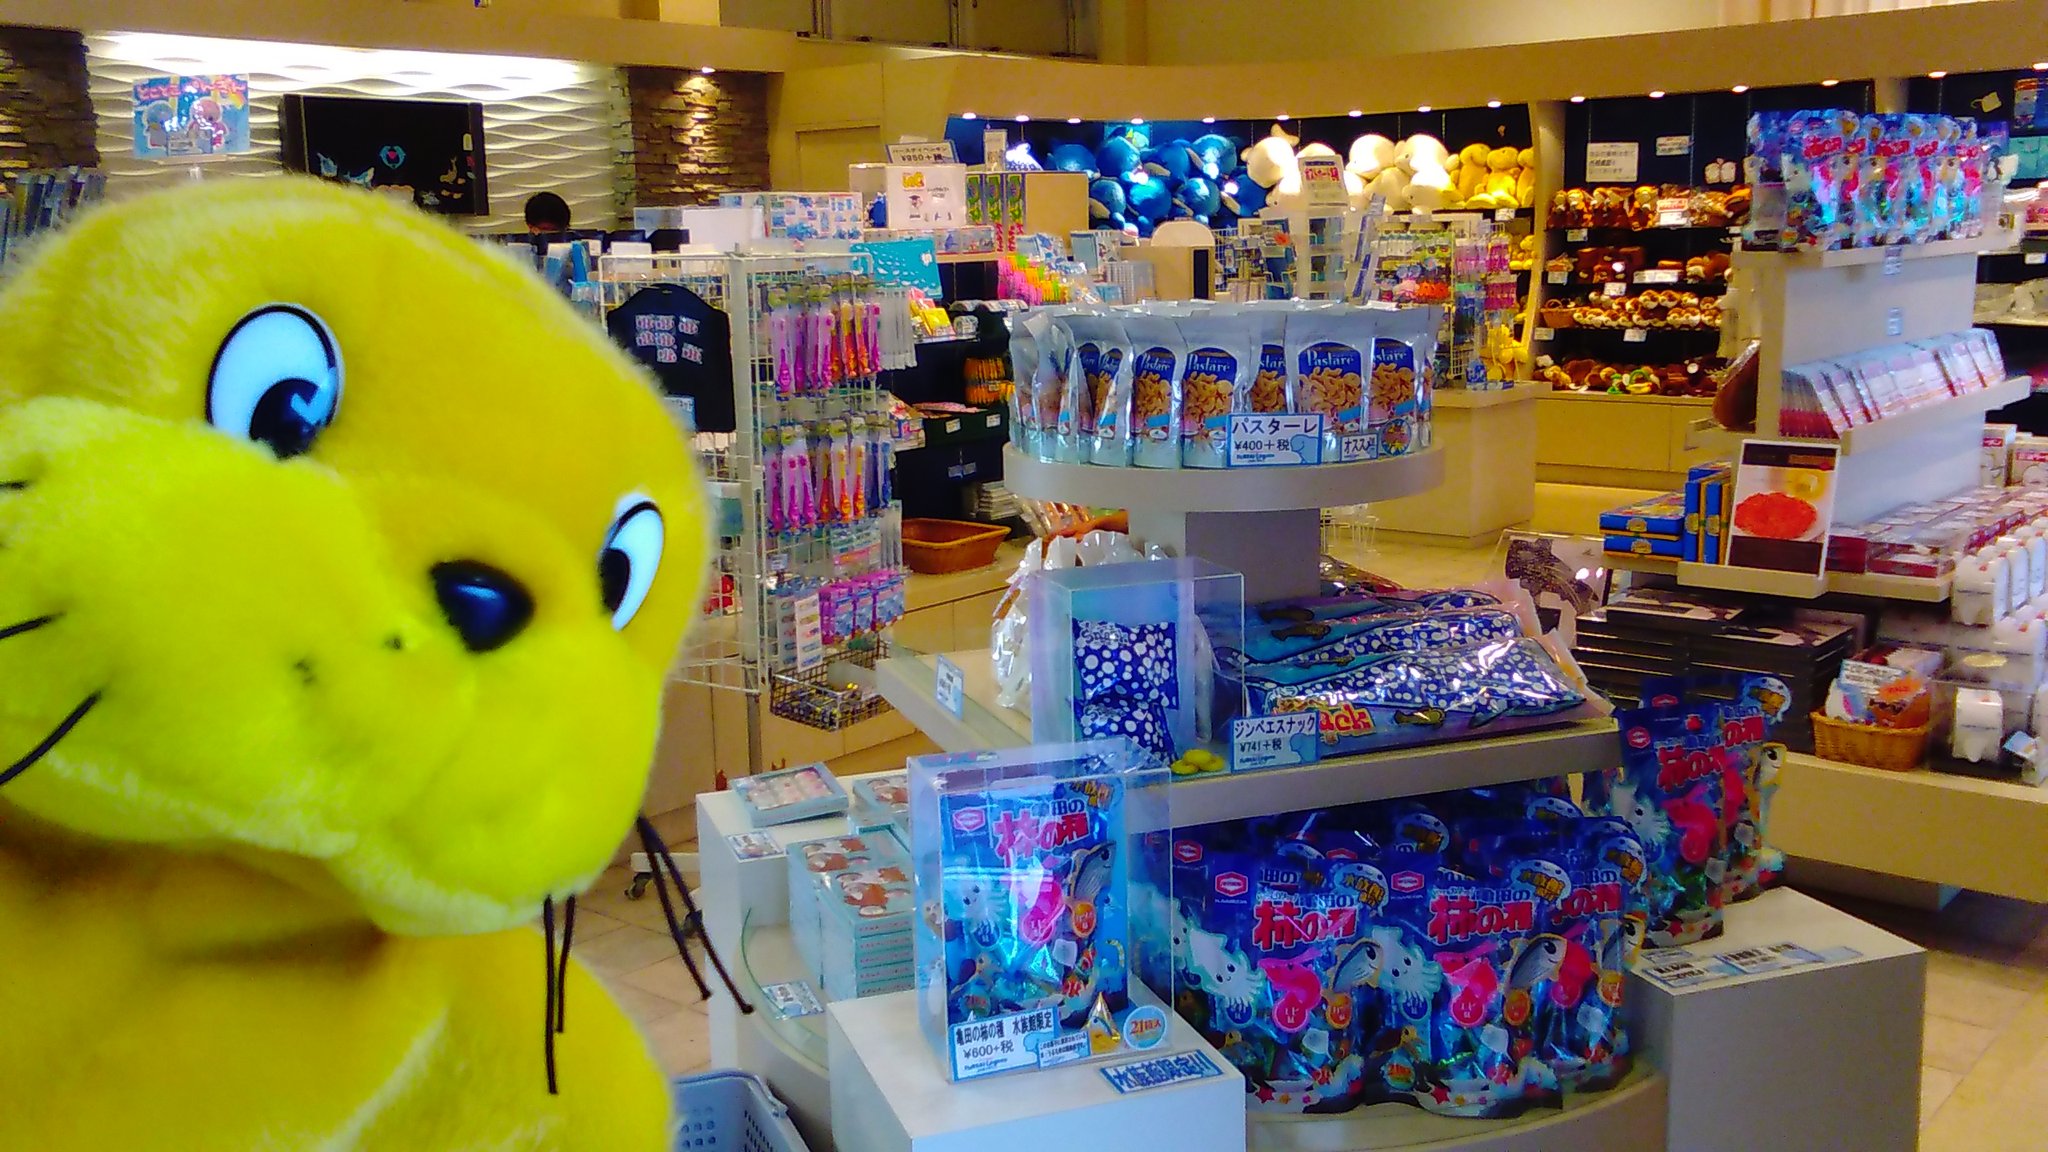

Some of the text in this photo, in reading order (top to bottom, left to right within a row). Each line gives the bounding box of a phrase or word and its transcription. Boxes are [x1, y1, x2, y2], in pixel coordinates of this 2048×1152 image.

[1232, 417, 1318, 435] パスターレ
[1234, 438, 1290, 452] ¥400+税
[1234, 715, 1315, 739] ジンベエスナック
[1318, 701, 1373, 731] ack
[1239, 738, 1282, 752] ¥741+税
[956, 1010, 1053, 1046] 亀田の柿の種 水族館限定
[963, 1038, 1015, 1060] ¥600+税
